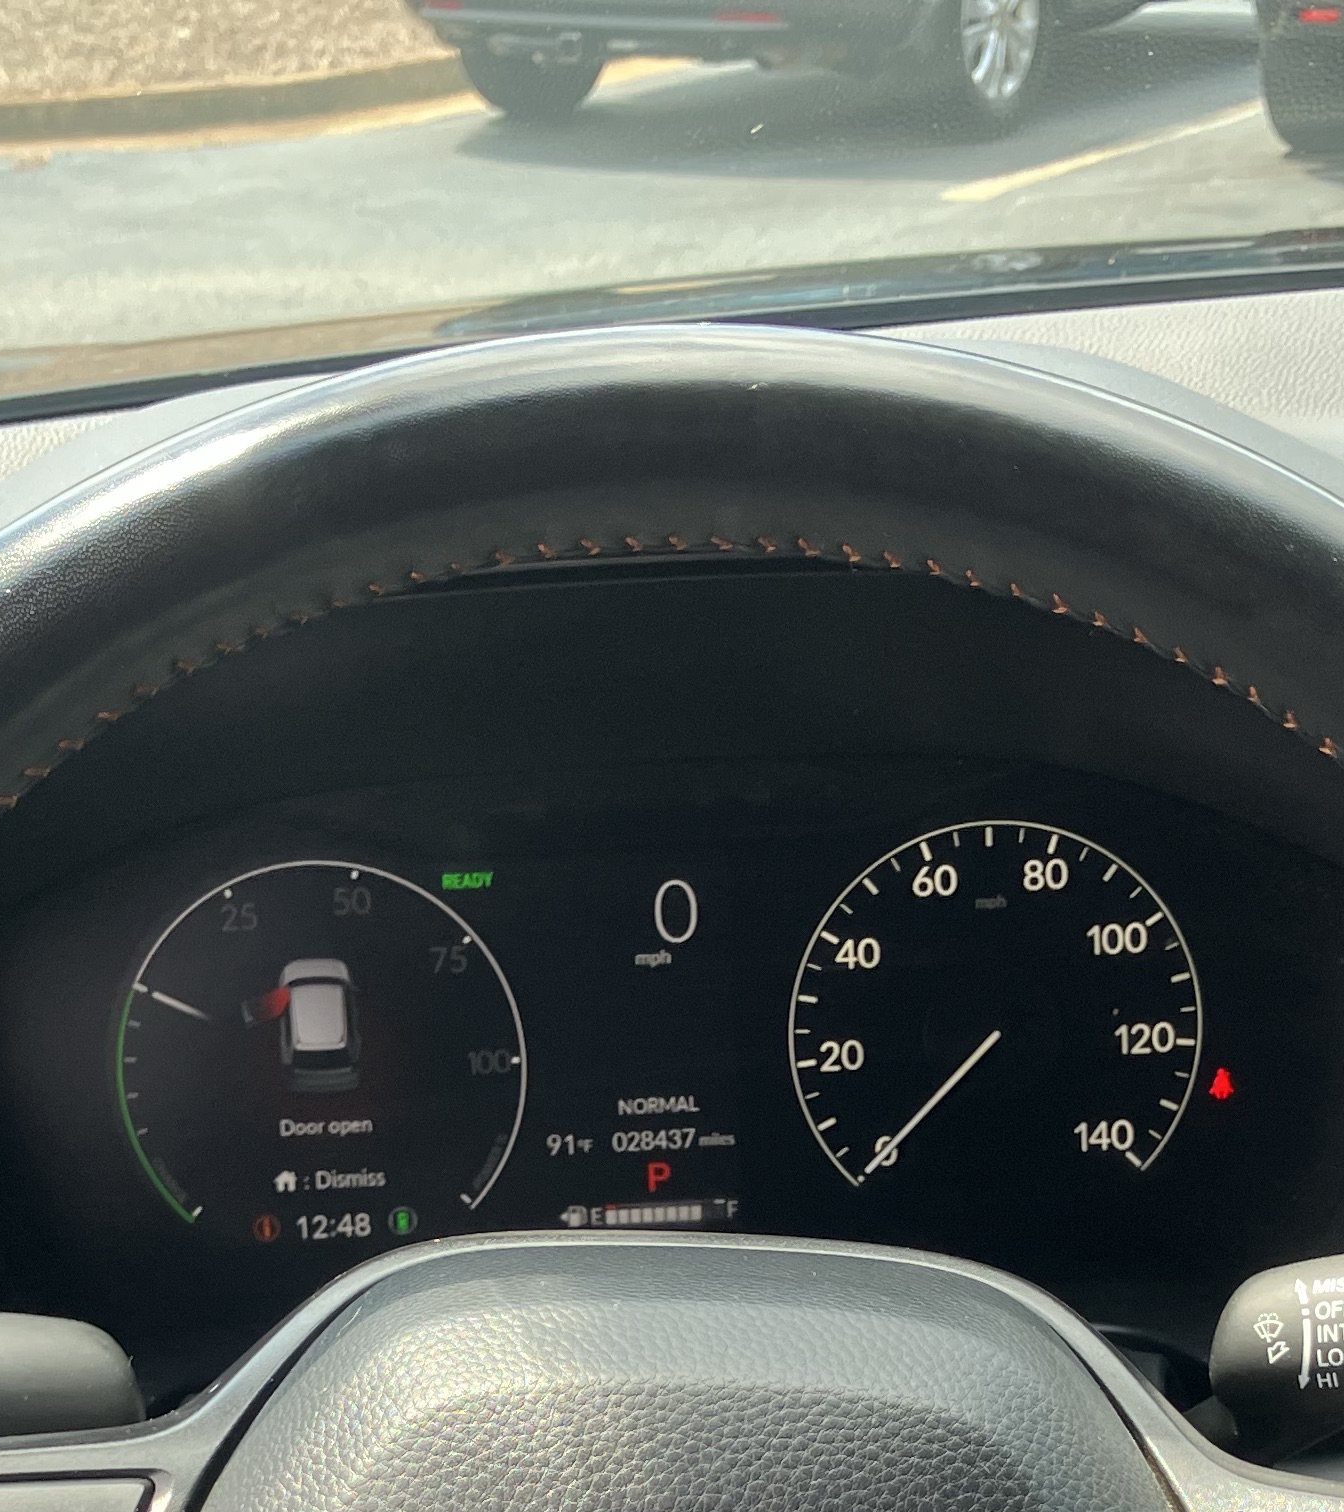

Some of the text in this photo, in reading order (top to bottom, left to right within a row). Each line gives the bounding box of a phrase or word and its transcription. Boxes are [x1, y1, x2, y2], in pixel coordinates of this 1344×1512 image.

[441, 871, 494, 891] READY
[912, 863, 958, 898] 60
[1022, 857, 1069, 892] 80
[333, 886, 372, 915] 50
[653, 879, 698, 944] 0
[220, 903, 258, 932] 25
[1086, 920, 1148, 957] 100
[429, 945, 468, 974] 75
[634, 949, 672, 968] mph
[834, 937, 882, 970] 40
[1114, 1020, 1175, 1055] 120
[467, 1051, 512, 1076] 100
[819, 1038, 865, 1073] 20
[617, 1094, 700, 1116] NORMAL
[278, 1118, 373, 1137] Door open
[611, 1127, 697, 1153] 028437
[1073, 1118, 1135, 1153] 140
[315, 1168, 386, 1191] Dismiss
[647, 1160, 673, 1192] P
[295, 1212, 372, 1241] 12:48
[1317, 1348, 1344, 1368] LO
[1316, 1372, 1339, 1390] HI
